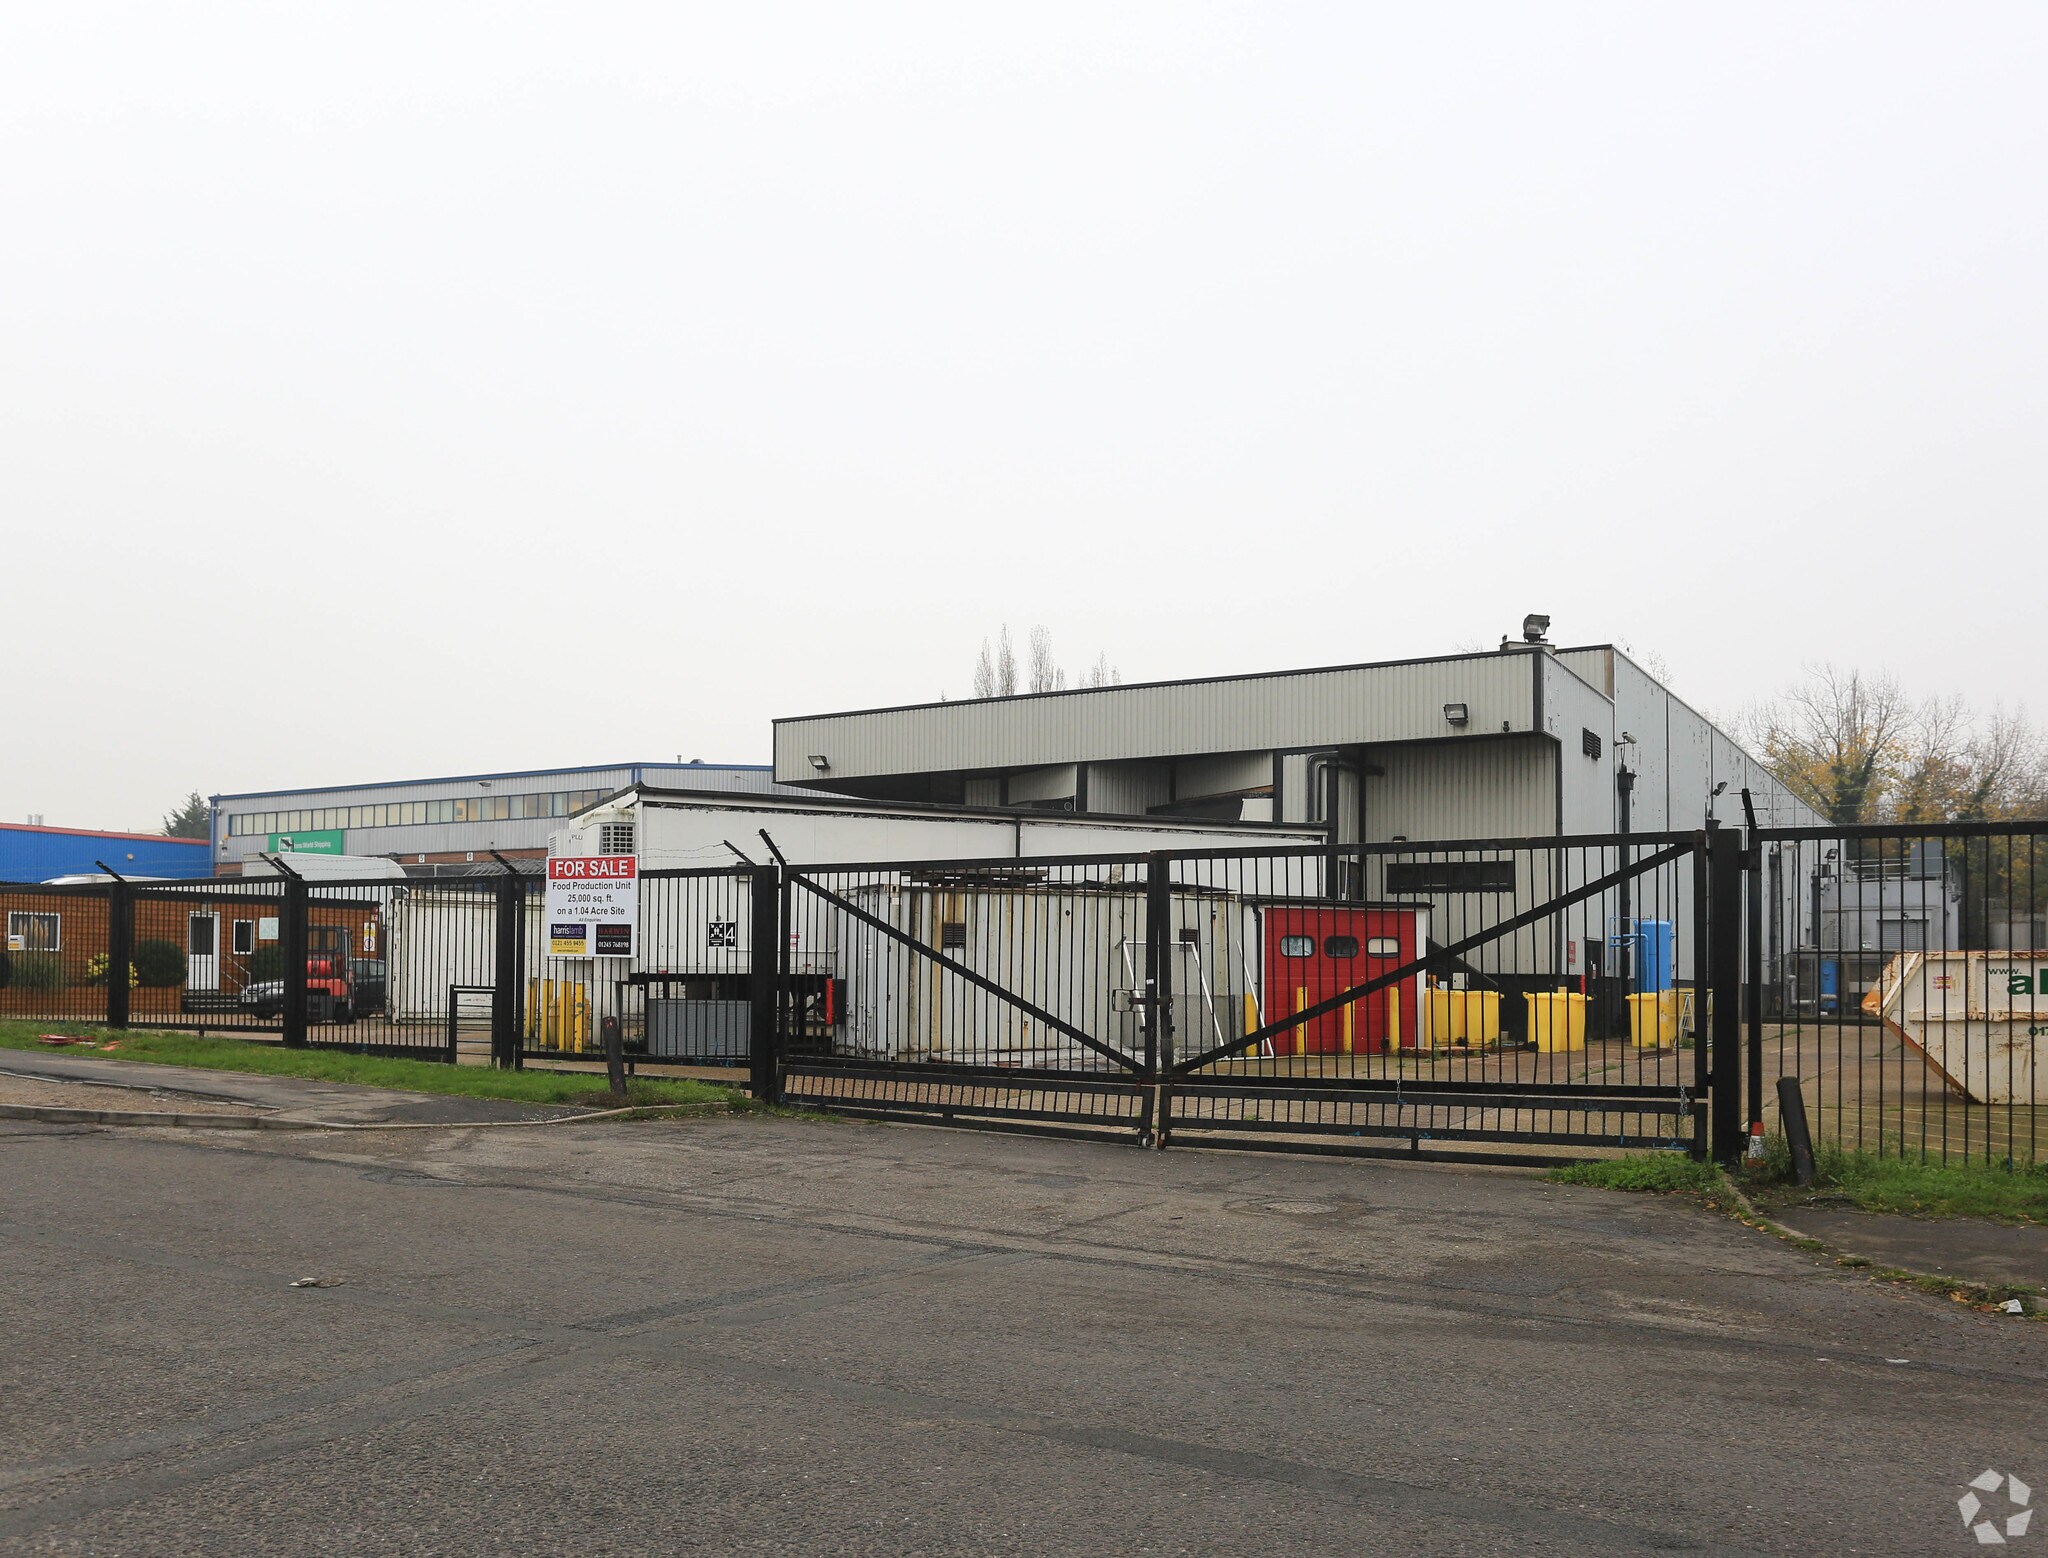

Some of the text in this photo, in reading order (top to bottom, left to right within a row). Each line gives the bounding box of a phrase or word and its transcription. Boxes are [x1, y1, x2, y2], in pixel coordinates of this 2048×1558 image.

[555, 860, 628, 877] FOR SALE
[552, 881, 631, 890] Food Production Unit
[567, 894, 591, 903] 25,000
[592, 895, 604, 904] sq.
[575, 907, 589, 915] 1.04
[591, 907, 608, 915] Acre
[610, 907, 625, 915] Site
[553, 925, 583, 935] harrislamb
[726, 926, 735, 943] 4
